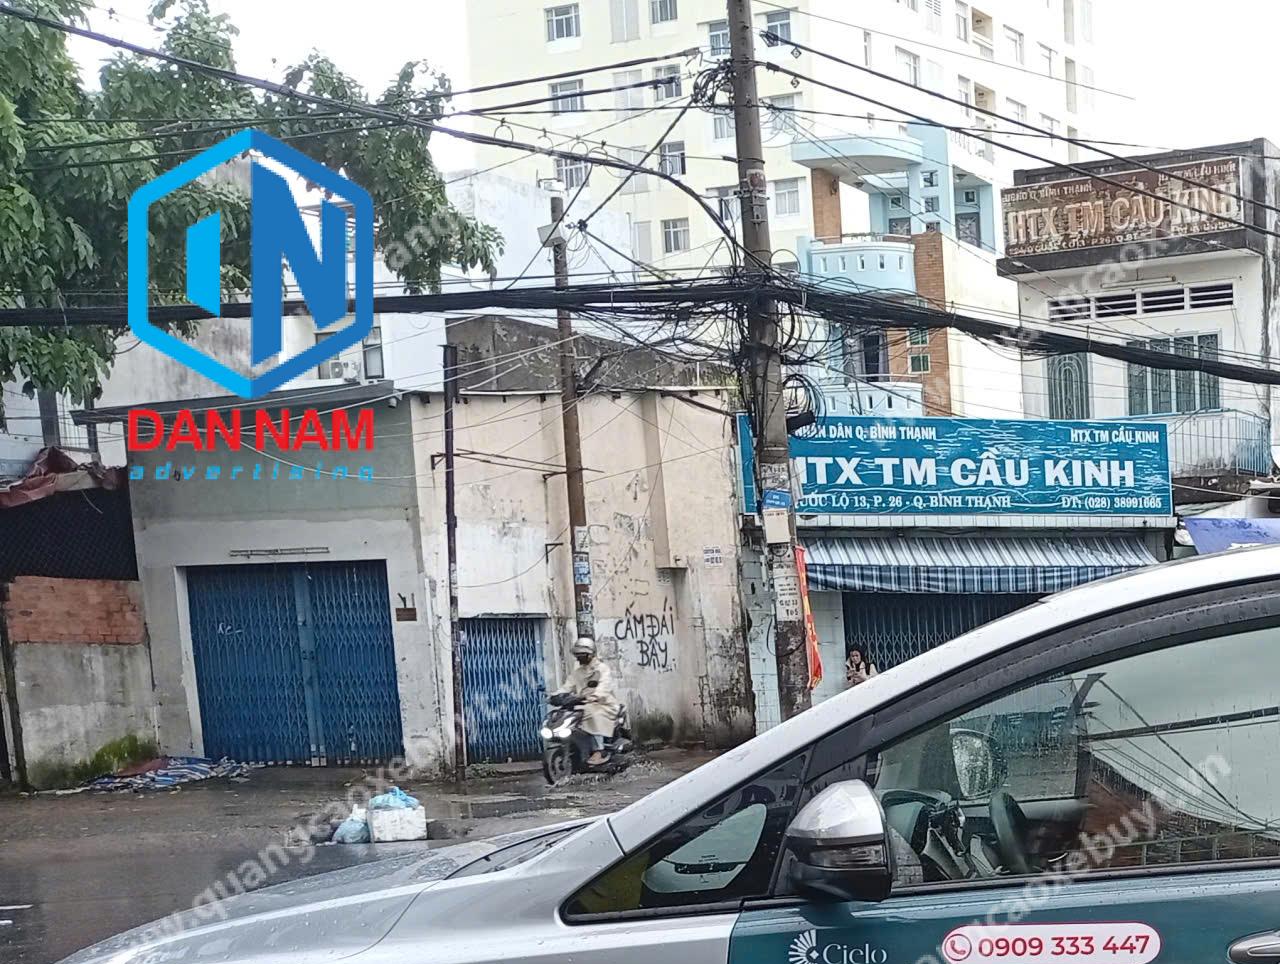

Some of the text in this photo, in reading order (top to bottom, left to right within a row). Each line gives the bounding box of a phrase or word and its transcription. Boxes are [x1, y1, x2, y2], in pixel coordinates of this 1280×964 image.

[1006, 206, 1061, 245] HTX
[829, 422, 852, 438] DÂN
[870, 423, 896, 438] BÌNH
[899, 426, 936, 441] THẠNH
[1071, 426, 1159, 443] HTX TM CẦU KINH
[875, 457, 936, 485] TM
[951, 447, 1029, 486] CẦU
[1044, 459, 1134, 487] KINH
[832, 492, 849, 509] LỘ
[889, 496, 902, 507] 26
[930, 492, 965, 508] BÌNH
[967, 496, 1011, 510] THẠNH
[978, 934, 1150, 957] 0909 333 447
